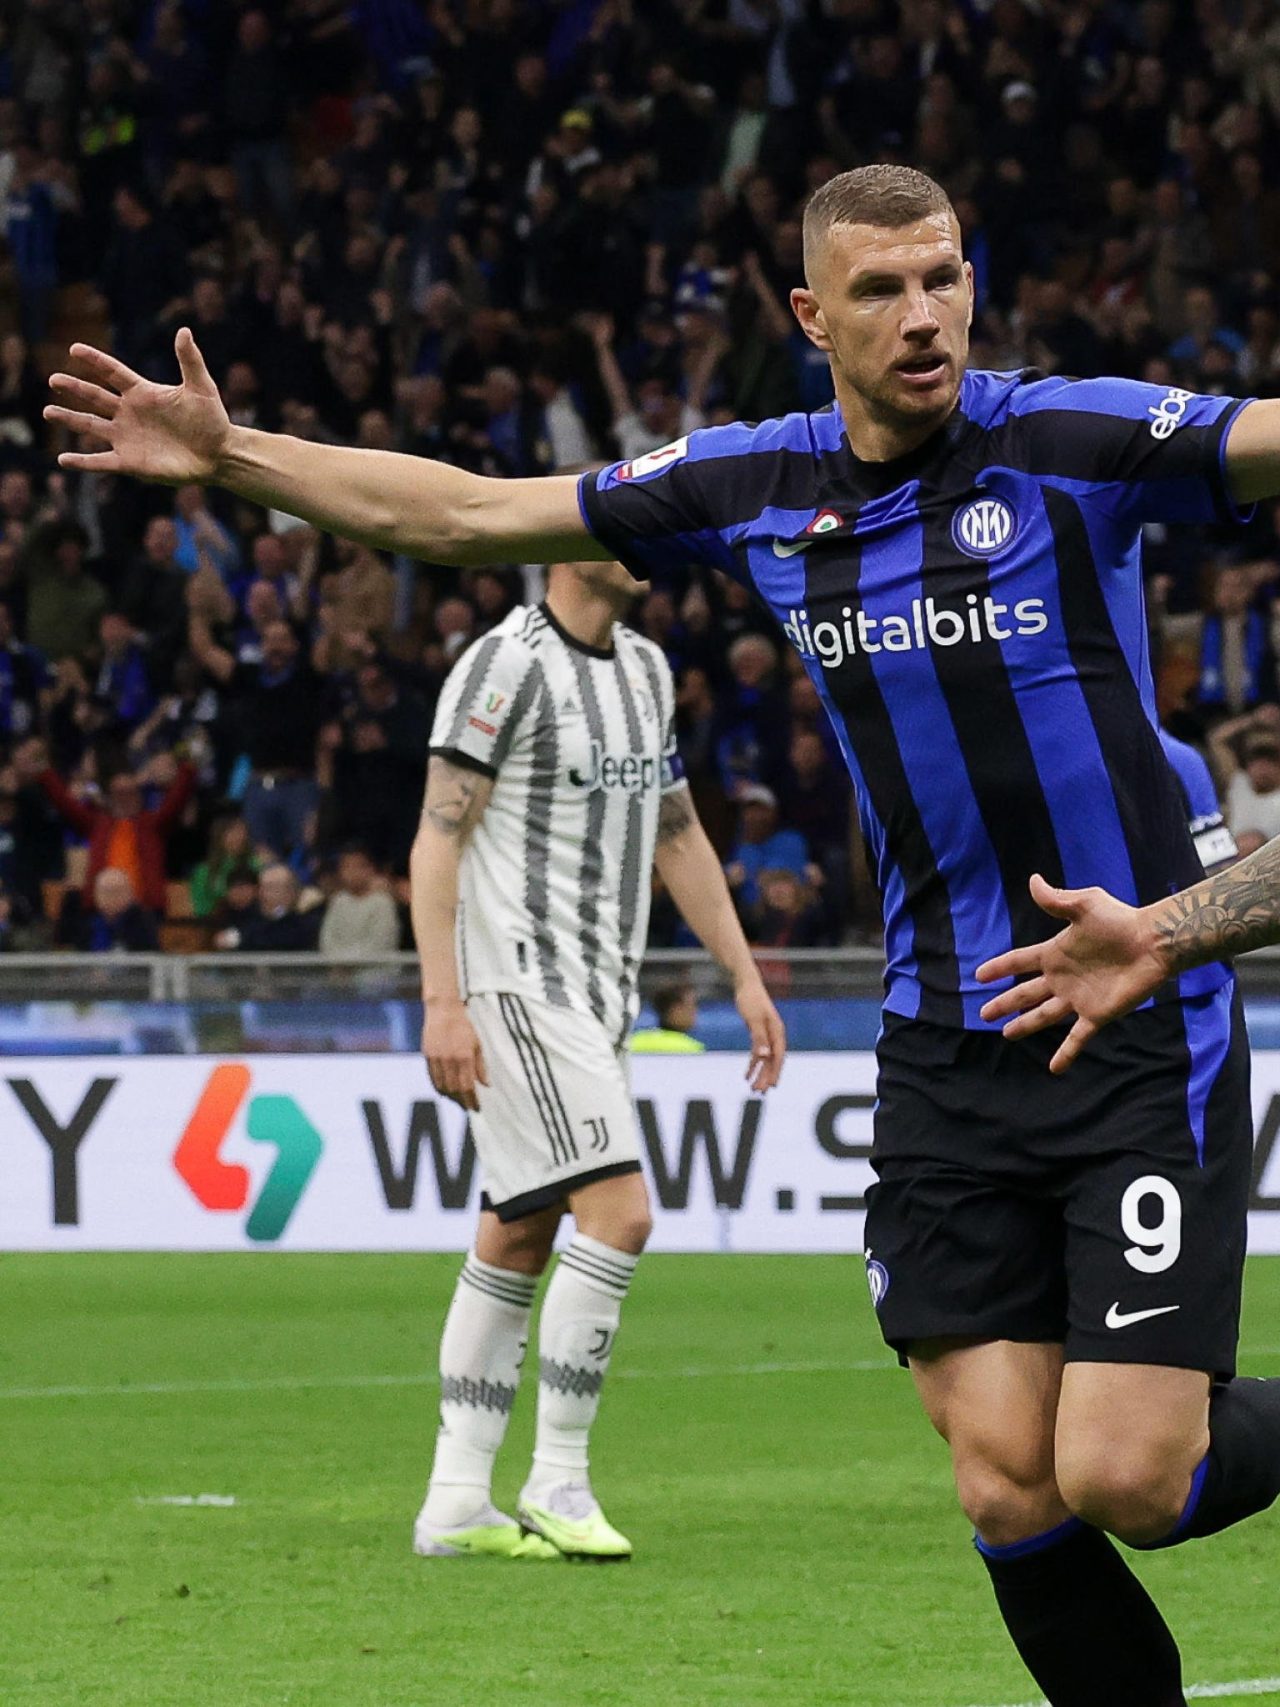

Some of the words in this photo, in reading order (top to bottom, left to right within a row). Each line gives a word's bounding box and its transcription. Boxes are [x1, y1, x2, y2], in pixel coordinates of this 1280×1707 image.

[1147, 388, 1195, 440] eba
[783, 593, 1049, 669] digitalbits
[1121, 1175, 1182, 1273] 9
